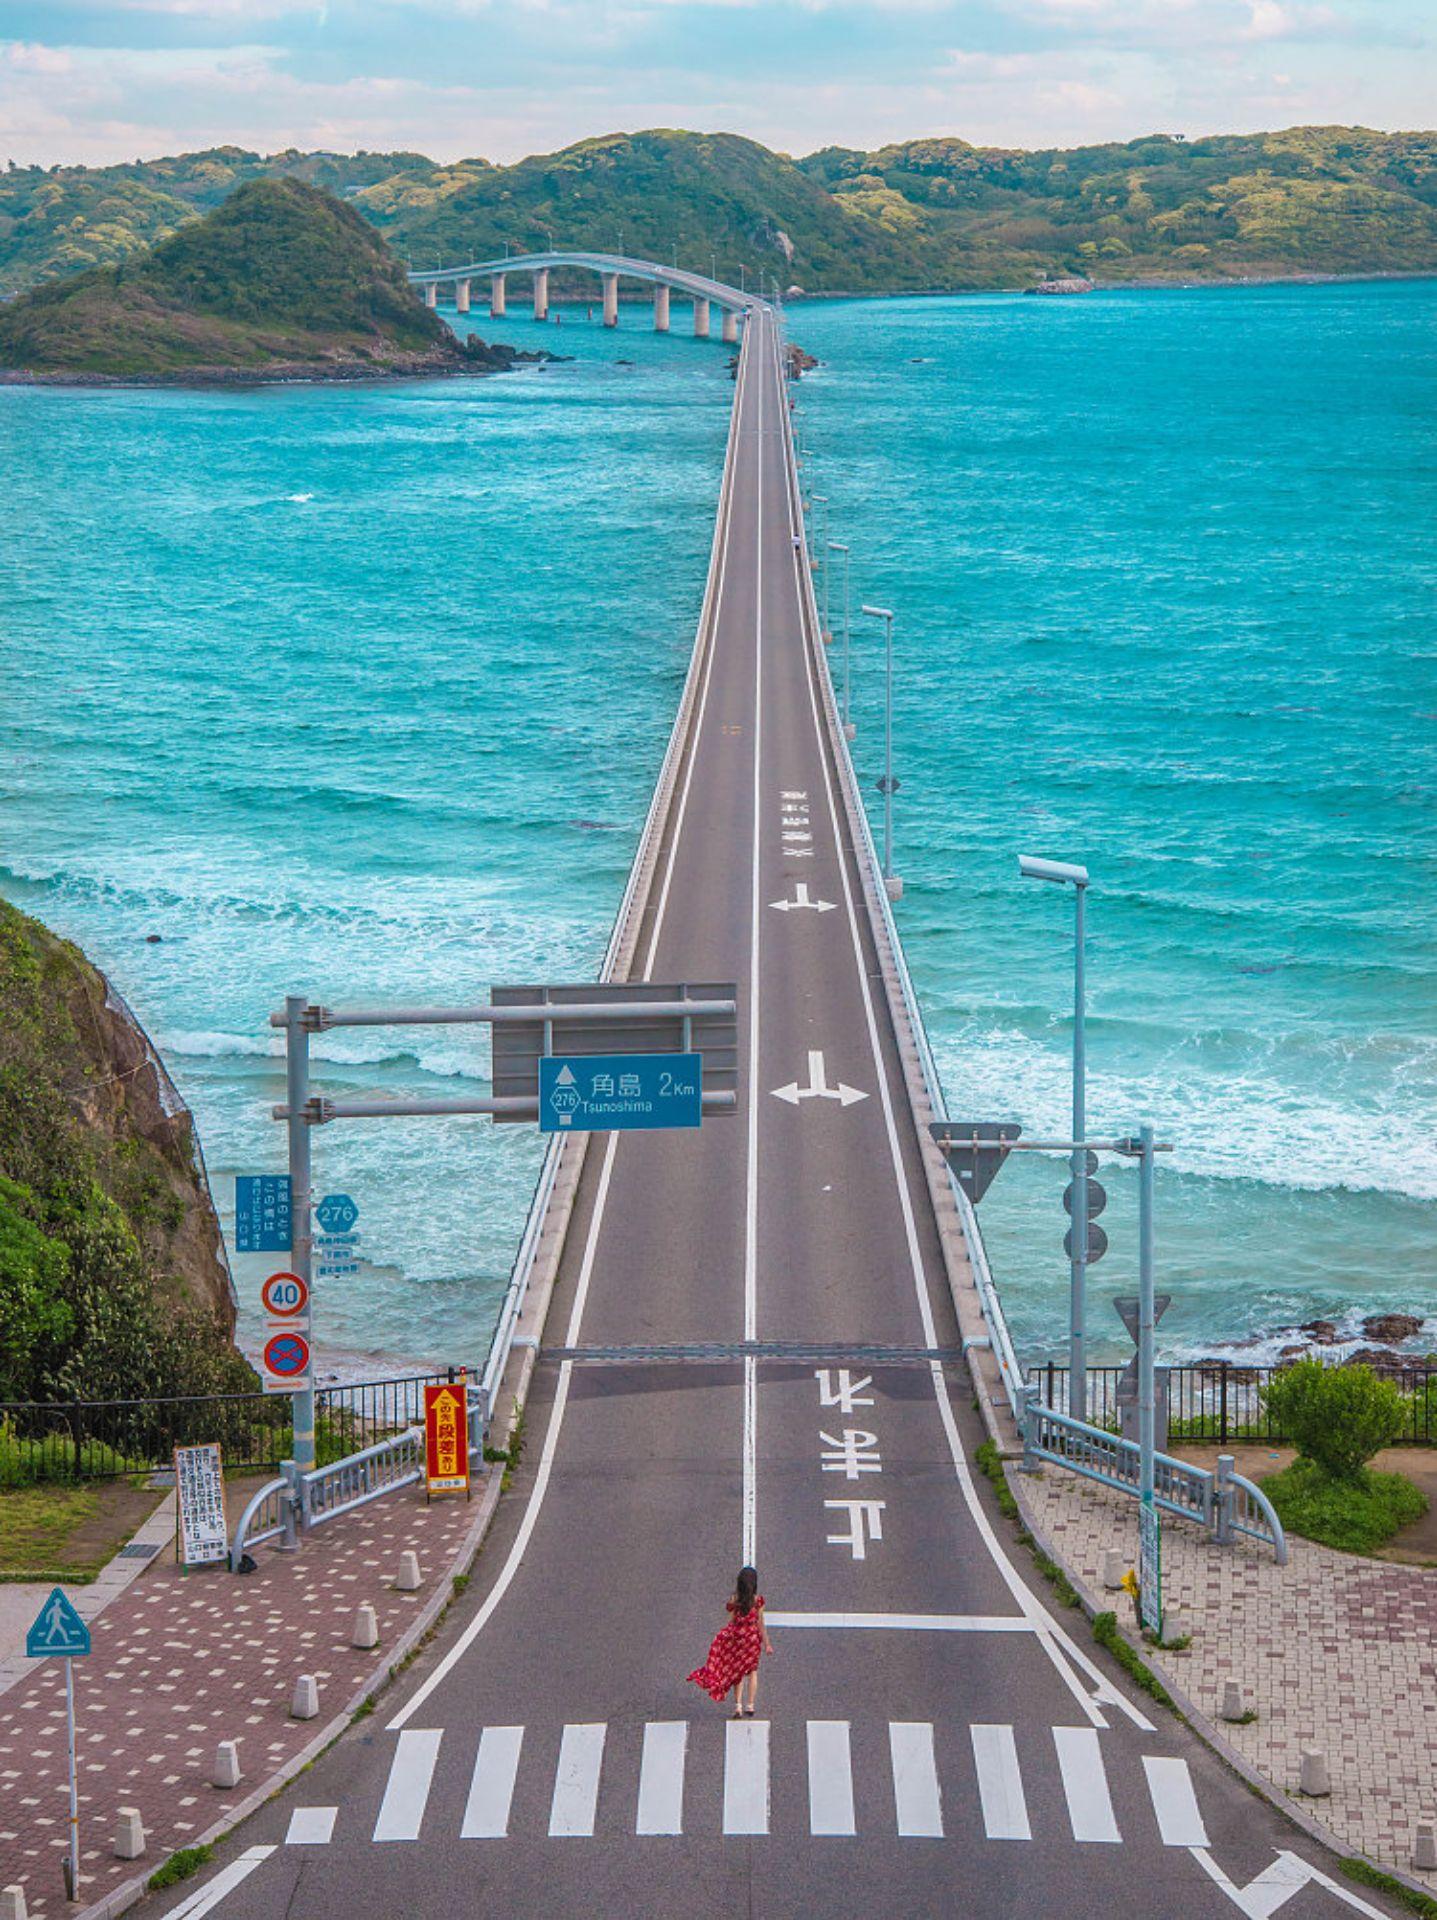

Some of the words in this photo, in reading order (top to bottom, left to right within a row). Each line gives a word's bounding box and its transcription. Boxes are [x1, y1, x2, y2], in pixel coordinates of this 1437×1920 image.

[591, 1073, 642, 1097] 角島
[556, 1093, 576, 1107] 276
[582, 1100, 653, 1114] Tsunoshima
[321, 1206, 354, 1221] 276
[272, 1284, 298, 1304] 40
[814, 1369, 886, 1560] 止まれ
